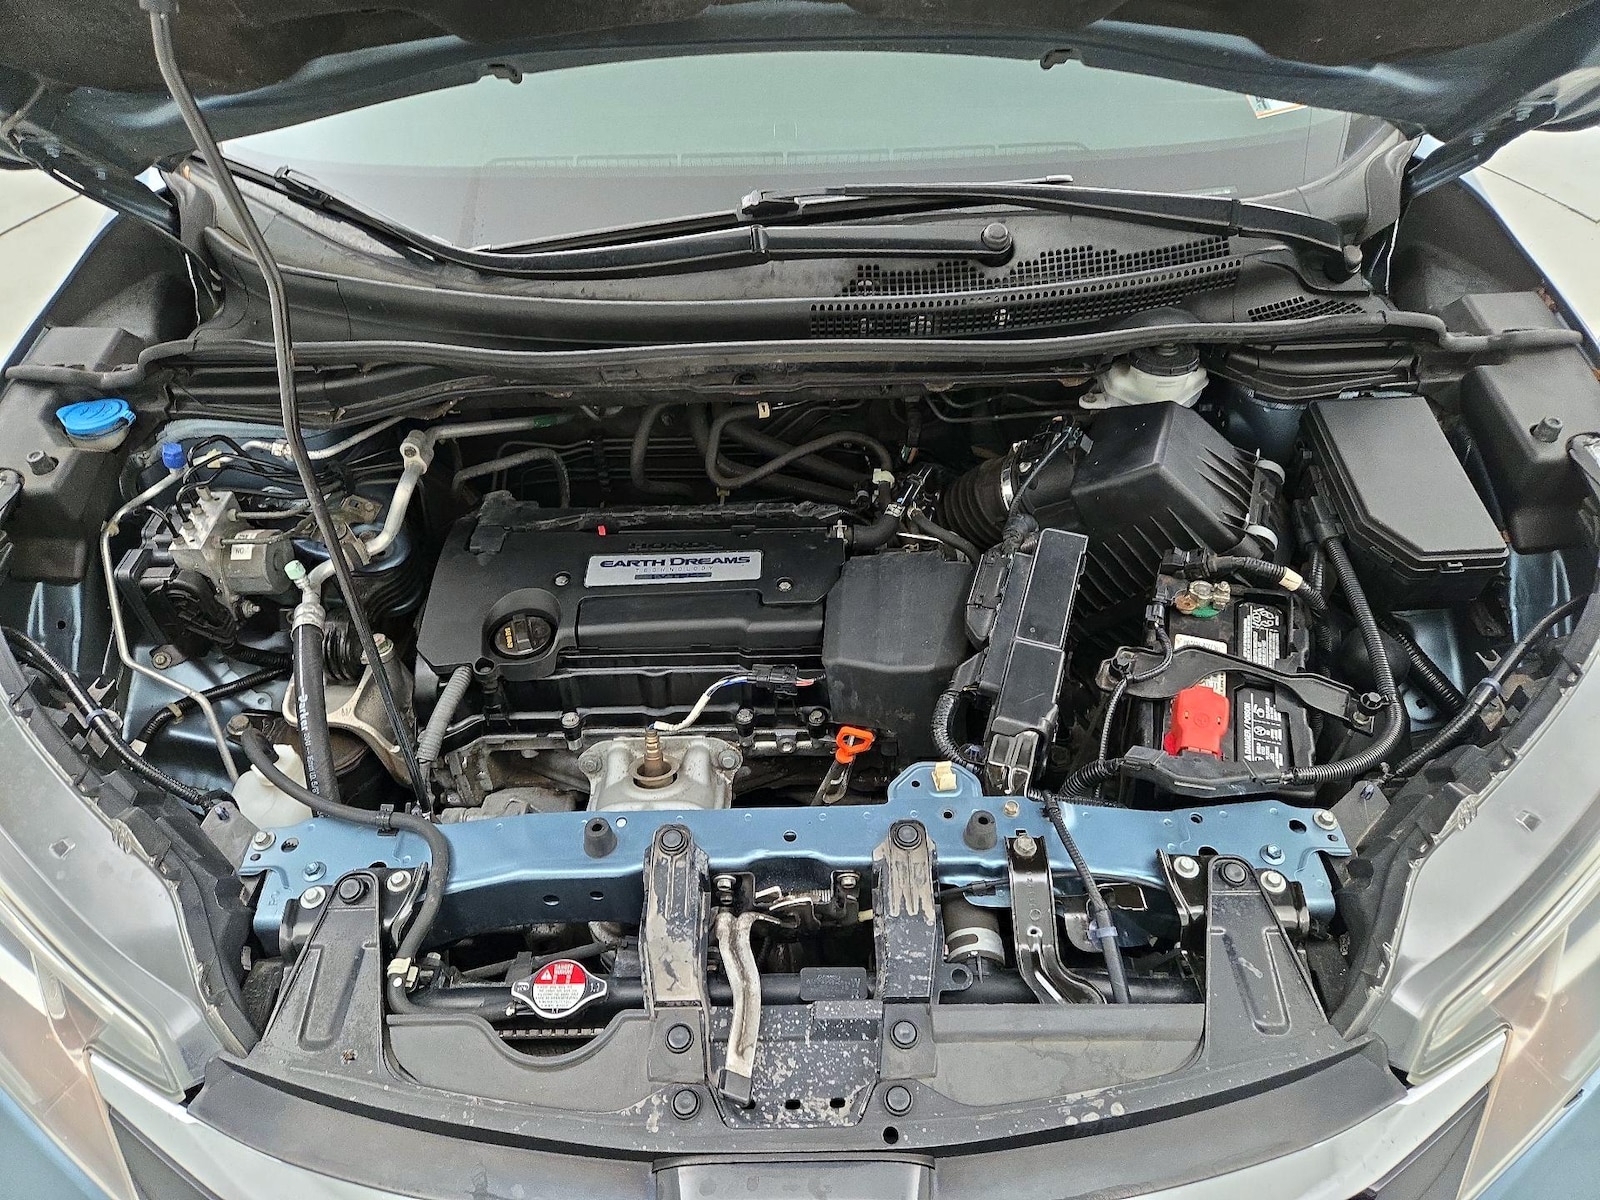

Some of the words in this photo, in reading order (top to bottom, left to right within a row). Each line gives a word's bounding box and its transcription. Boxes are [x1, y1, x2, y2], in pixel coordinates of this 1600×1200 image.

[600, 559, 666, 568] EARTH
[669, 556, 751, 566] DREAMS
[298, 694, 309, 731] Parker
